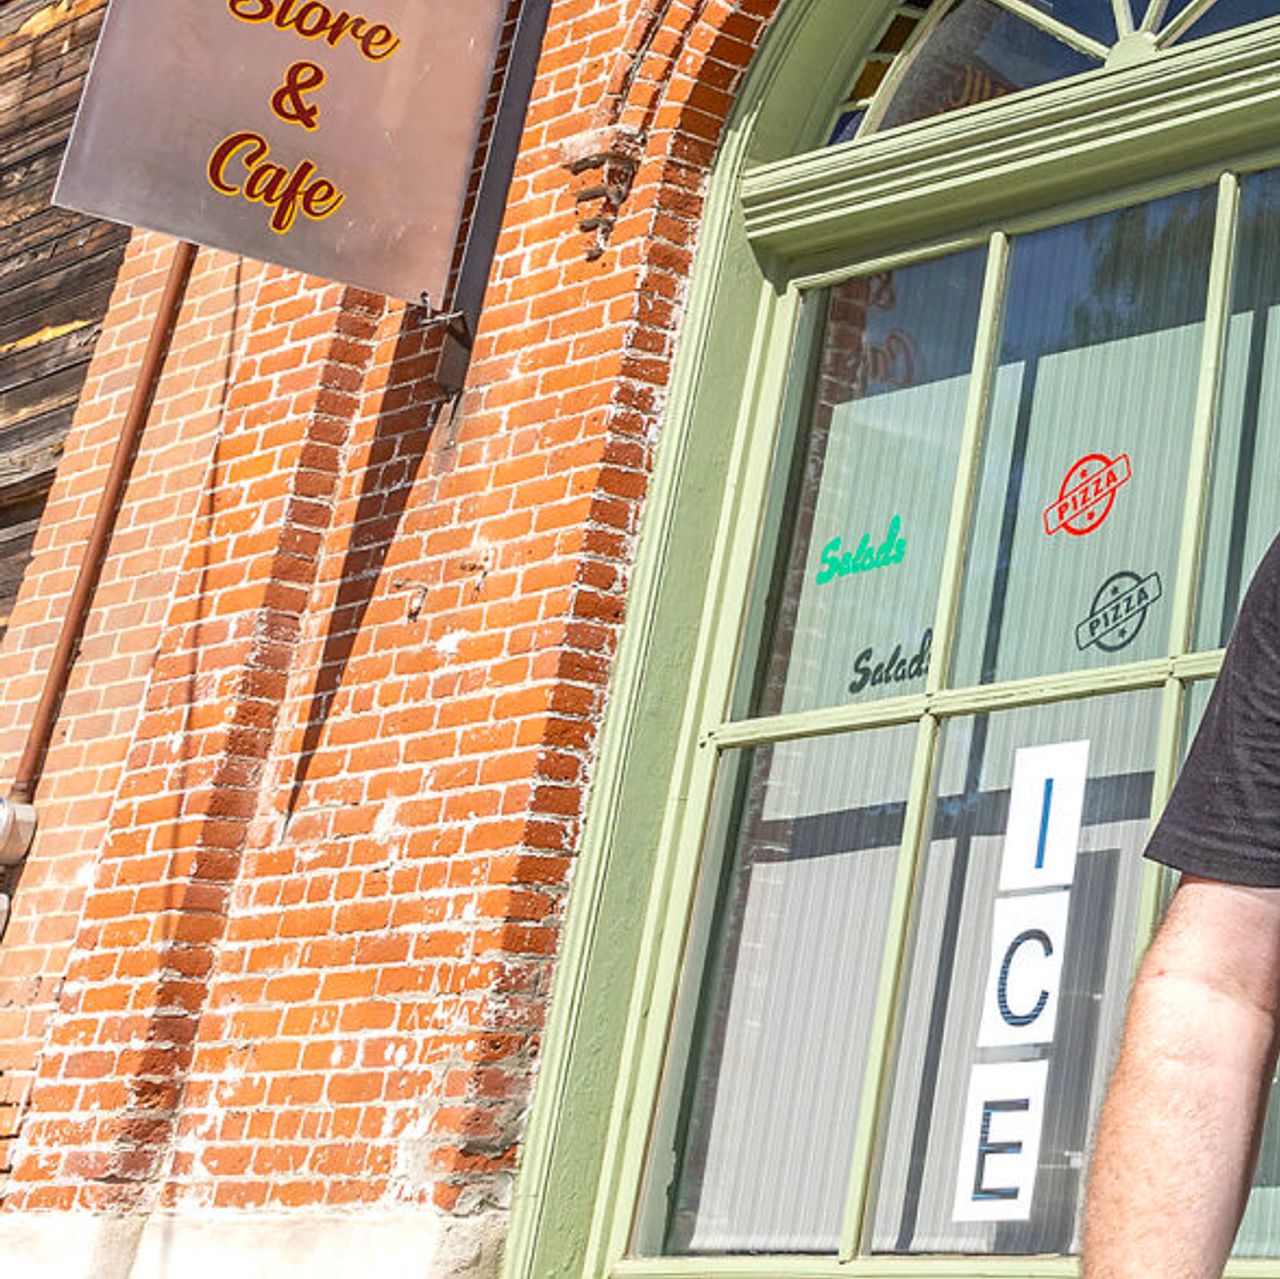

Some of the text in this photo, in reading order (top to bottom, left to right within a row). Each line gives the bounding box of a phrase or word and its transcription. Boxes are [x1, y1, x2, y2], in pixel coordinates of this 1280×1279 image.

[271, 60, 327, 131] &
[207, 131, 346, 235] Cafe
[1056, 469, 1119, 521] PIZZA
[815, 513, 908, 586] Salads
[1088, 587, 1150, 638] PIZZA
[848, 627, 933, 694] Salad
[971, 776, 1054, 1202] ICE
